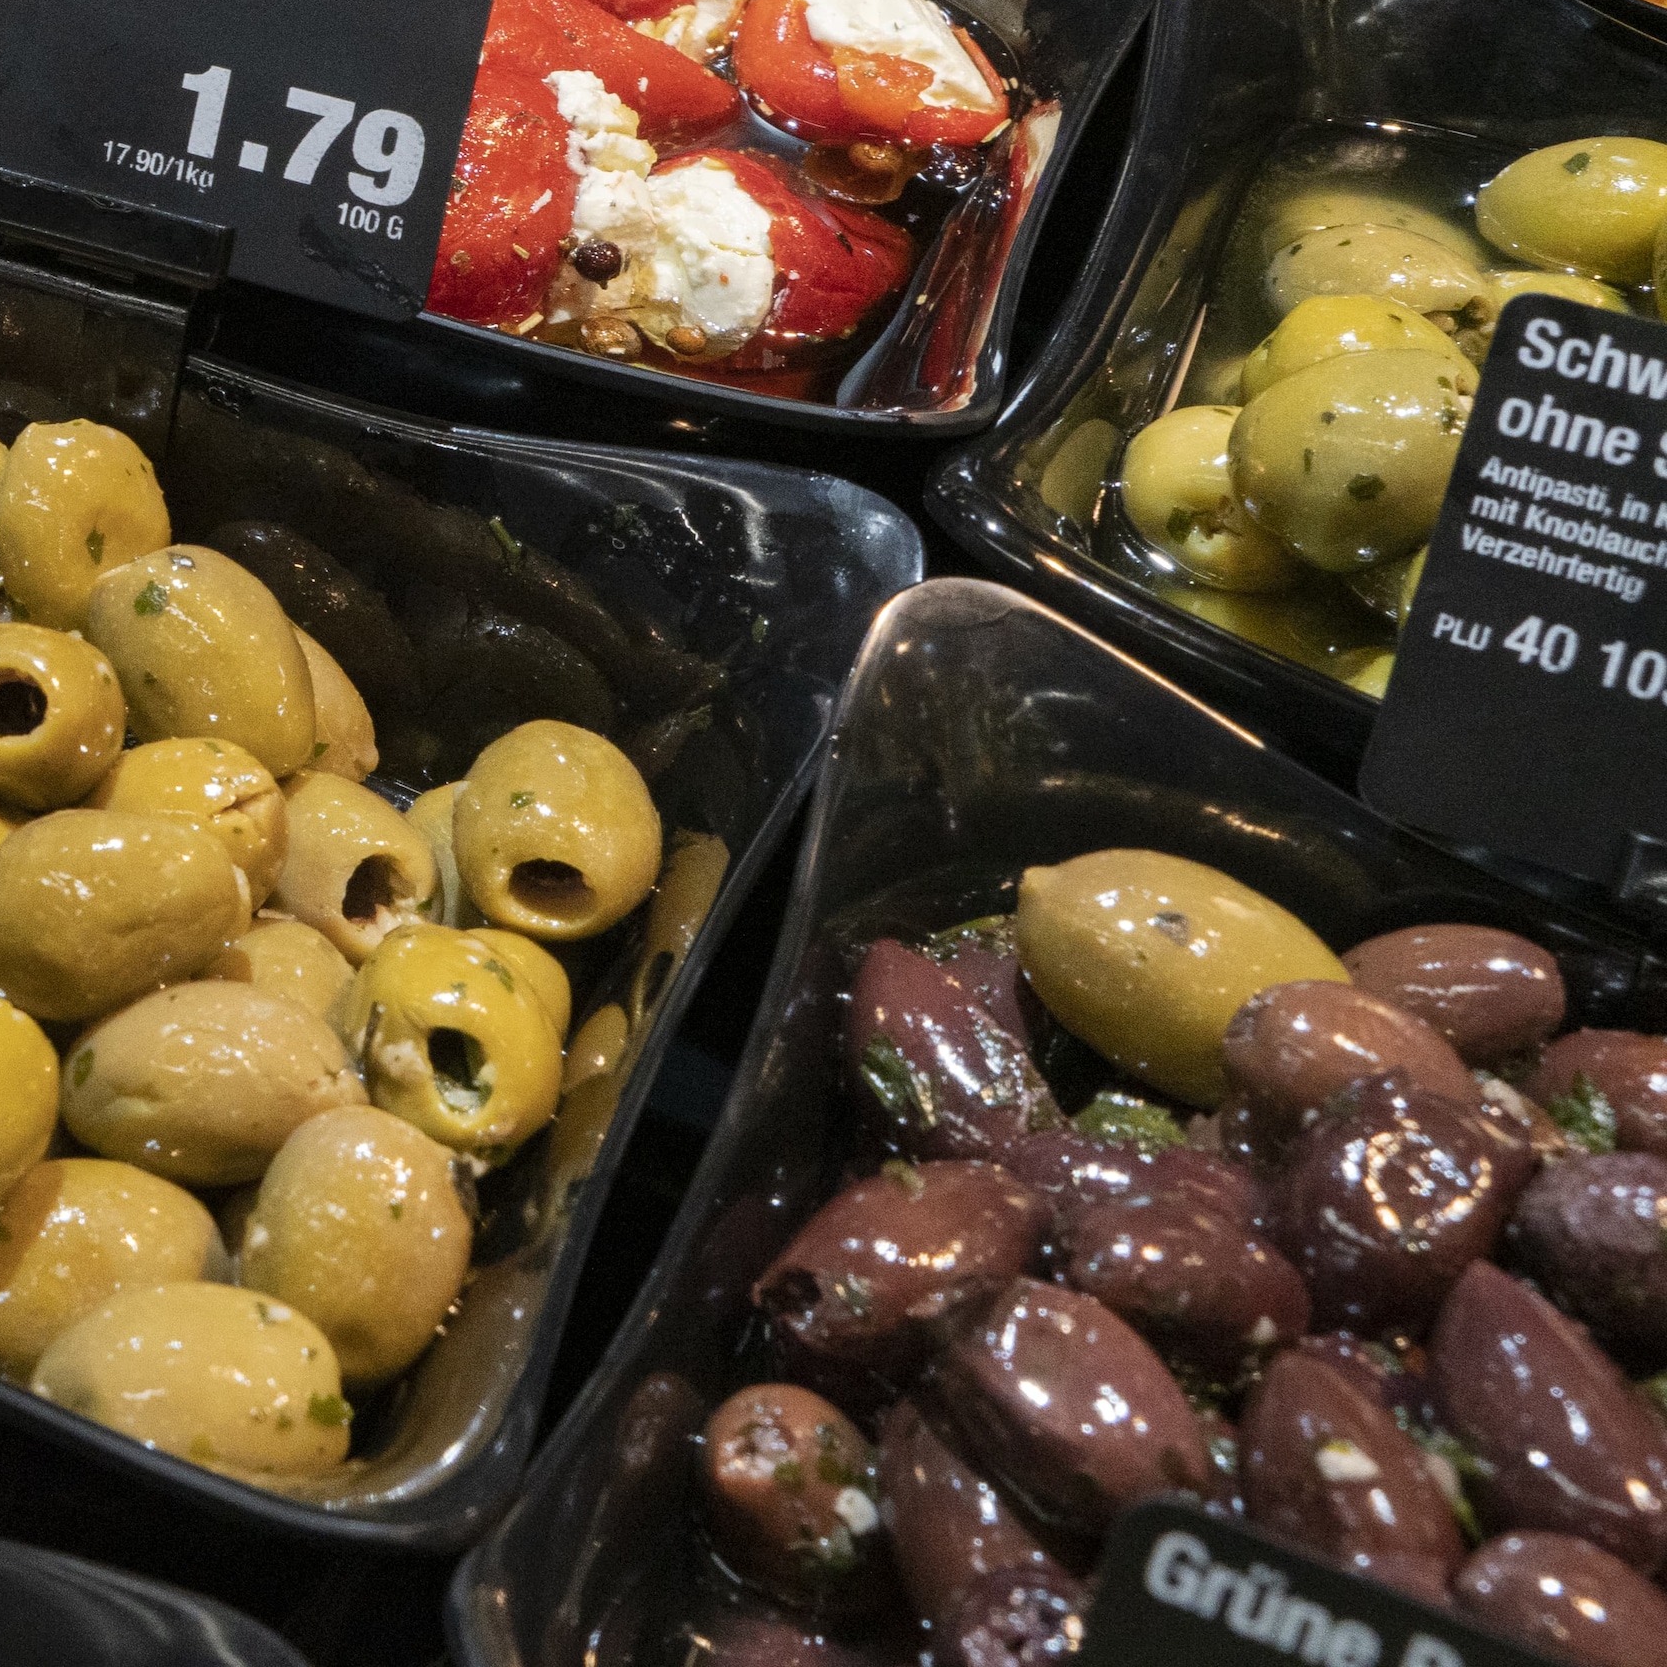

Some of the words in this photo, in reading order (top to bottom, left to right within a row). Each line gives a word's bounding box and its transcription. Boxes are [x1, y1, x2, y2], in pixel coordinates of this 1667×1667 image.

[103, 139, 215, 193] 17.90/1kg
[182, 65, 425, 207] 1.79
[337, 202, 380, 234] 100
[1498, 394, 1639, 466] ohne
[1480, 456, 1611, 517] Antipasti,
[1460, 523, 1646, 603] Verzehrfertig
[1433, 611, 1491, 651] PLU
[1503, 615, 1578, 674] 40
[1144, 1531, 1381, 1667] Grüne
